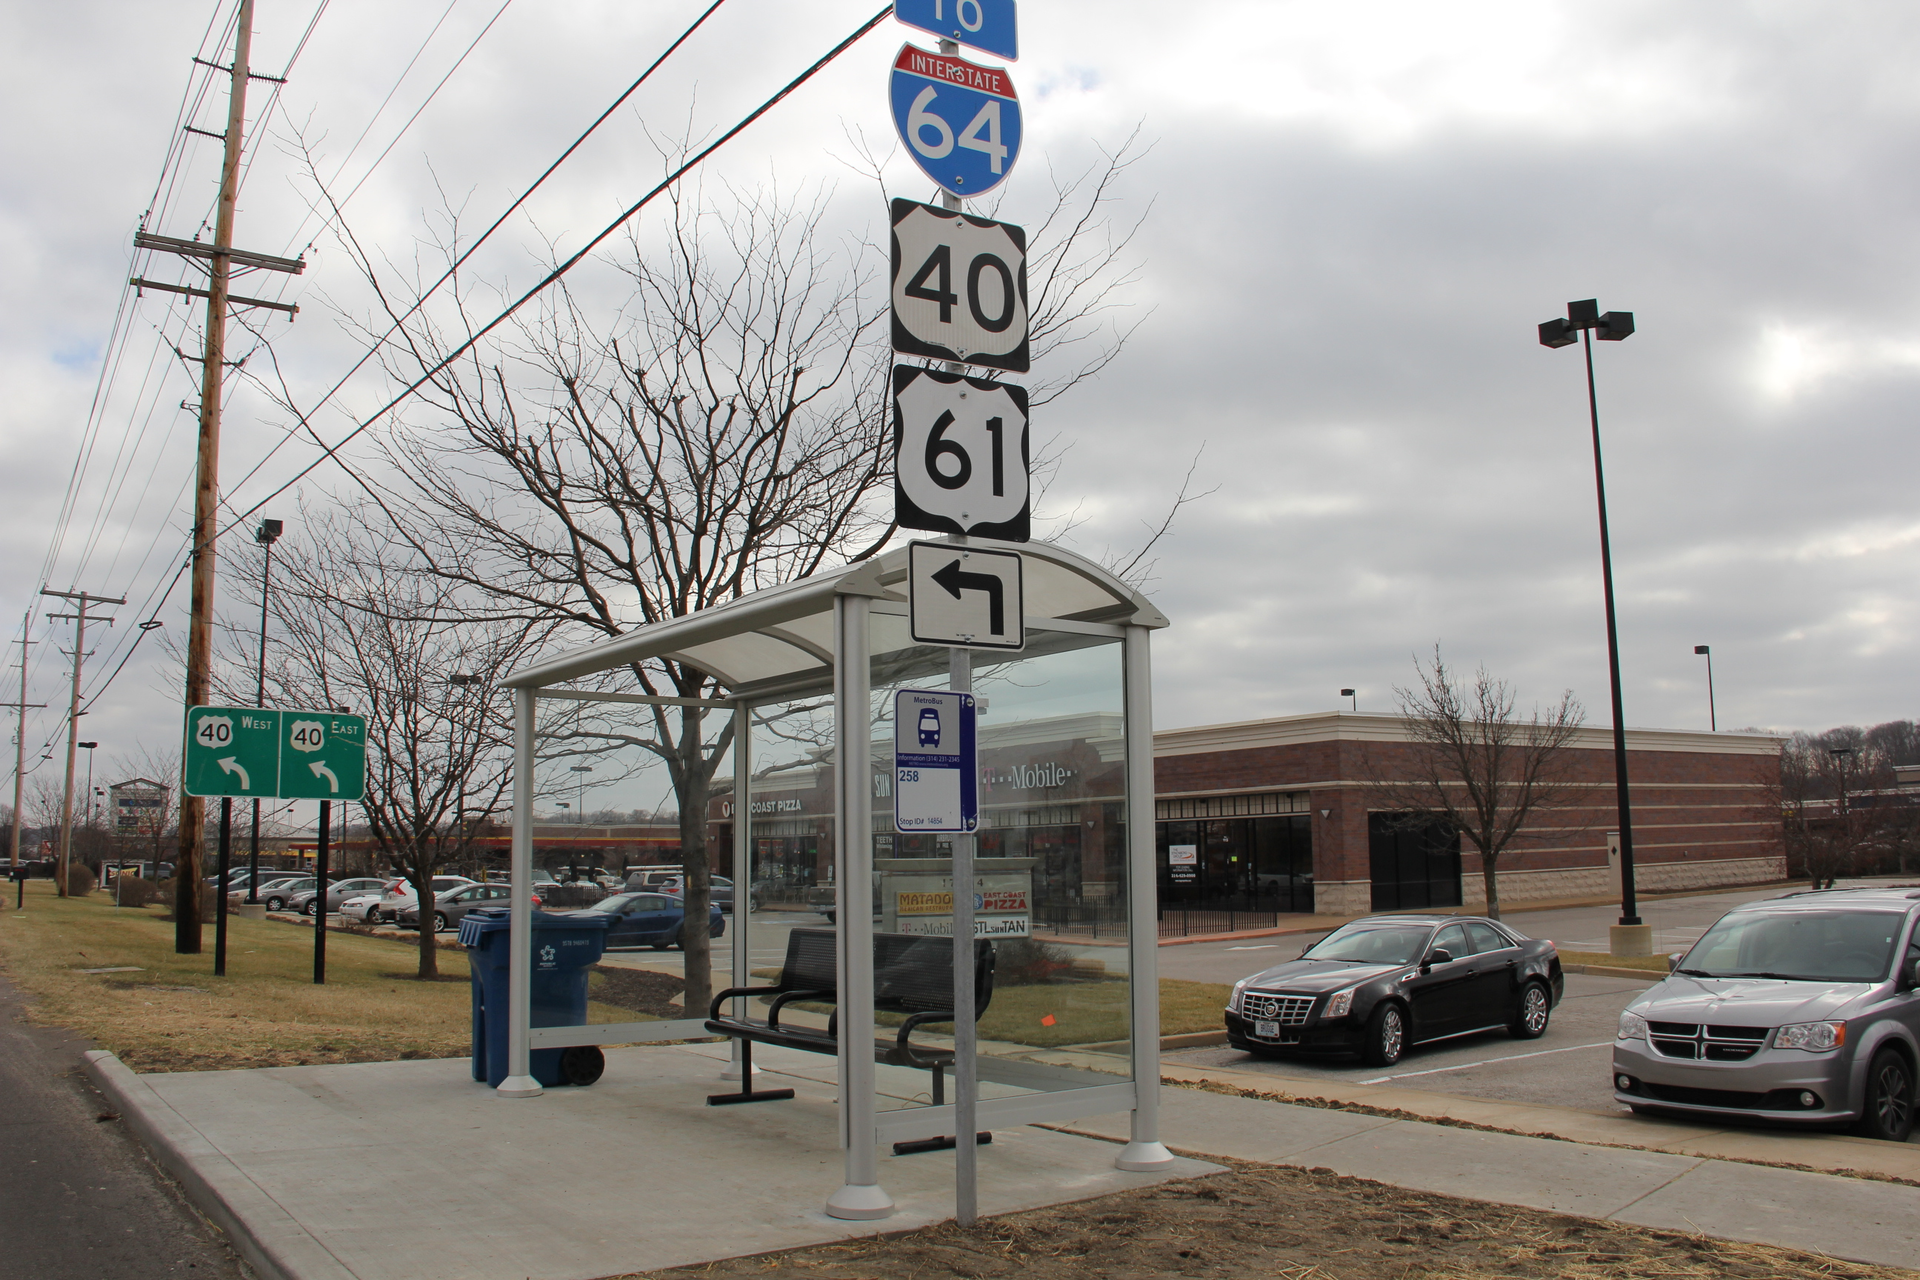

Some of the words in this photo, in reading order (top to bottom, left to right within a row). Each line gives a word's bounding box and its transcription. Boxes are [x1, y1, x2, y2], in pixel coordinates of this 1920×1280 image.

[911, 54, 1000, 92] INTERSTATE
[907, 85, 1008, 175] 64
[904, 244, 1016, 333] 40
[924, 408, 1004, 497] 61
[913, 696, 943, 705] MetroBus
[200, 723, 230, 742] 40
[294, 728, 322, 746] 40
[899, 770, 919, 782] 258
[874, 773, 891, 798] SUN
[751, 801, 776, 813] COAST
[777, 799, 801, 812] PIZZA
[899, 817, 913, 826] Stop
[914, 817, 925, 825] ID#
[876, 835, 893, 844] TEETH
[1003, 891, 1027, 899] COAST
[983, 899, 1028, 910] PIZZA
[923, 922, 954, 935] Mobil
